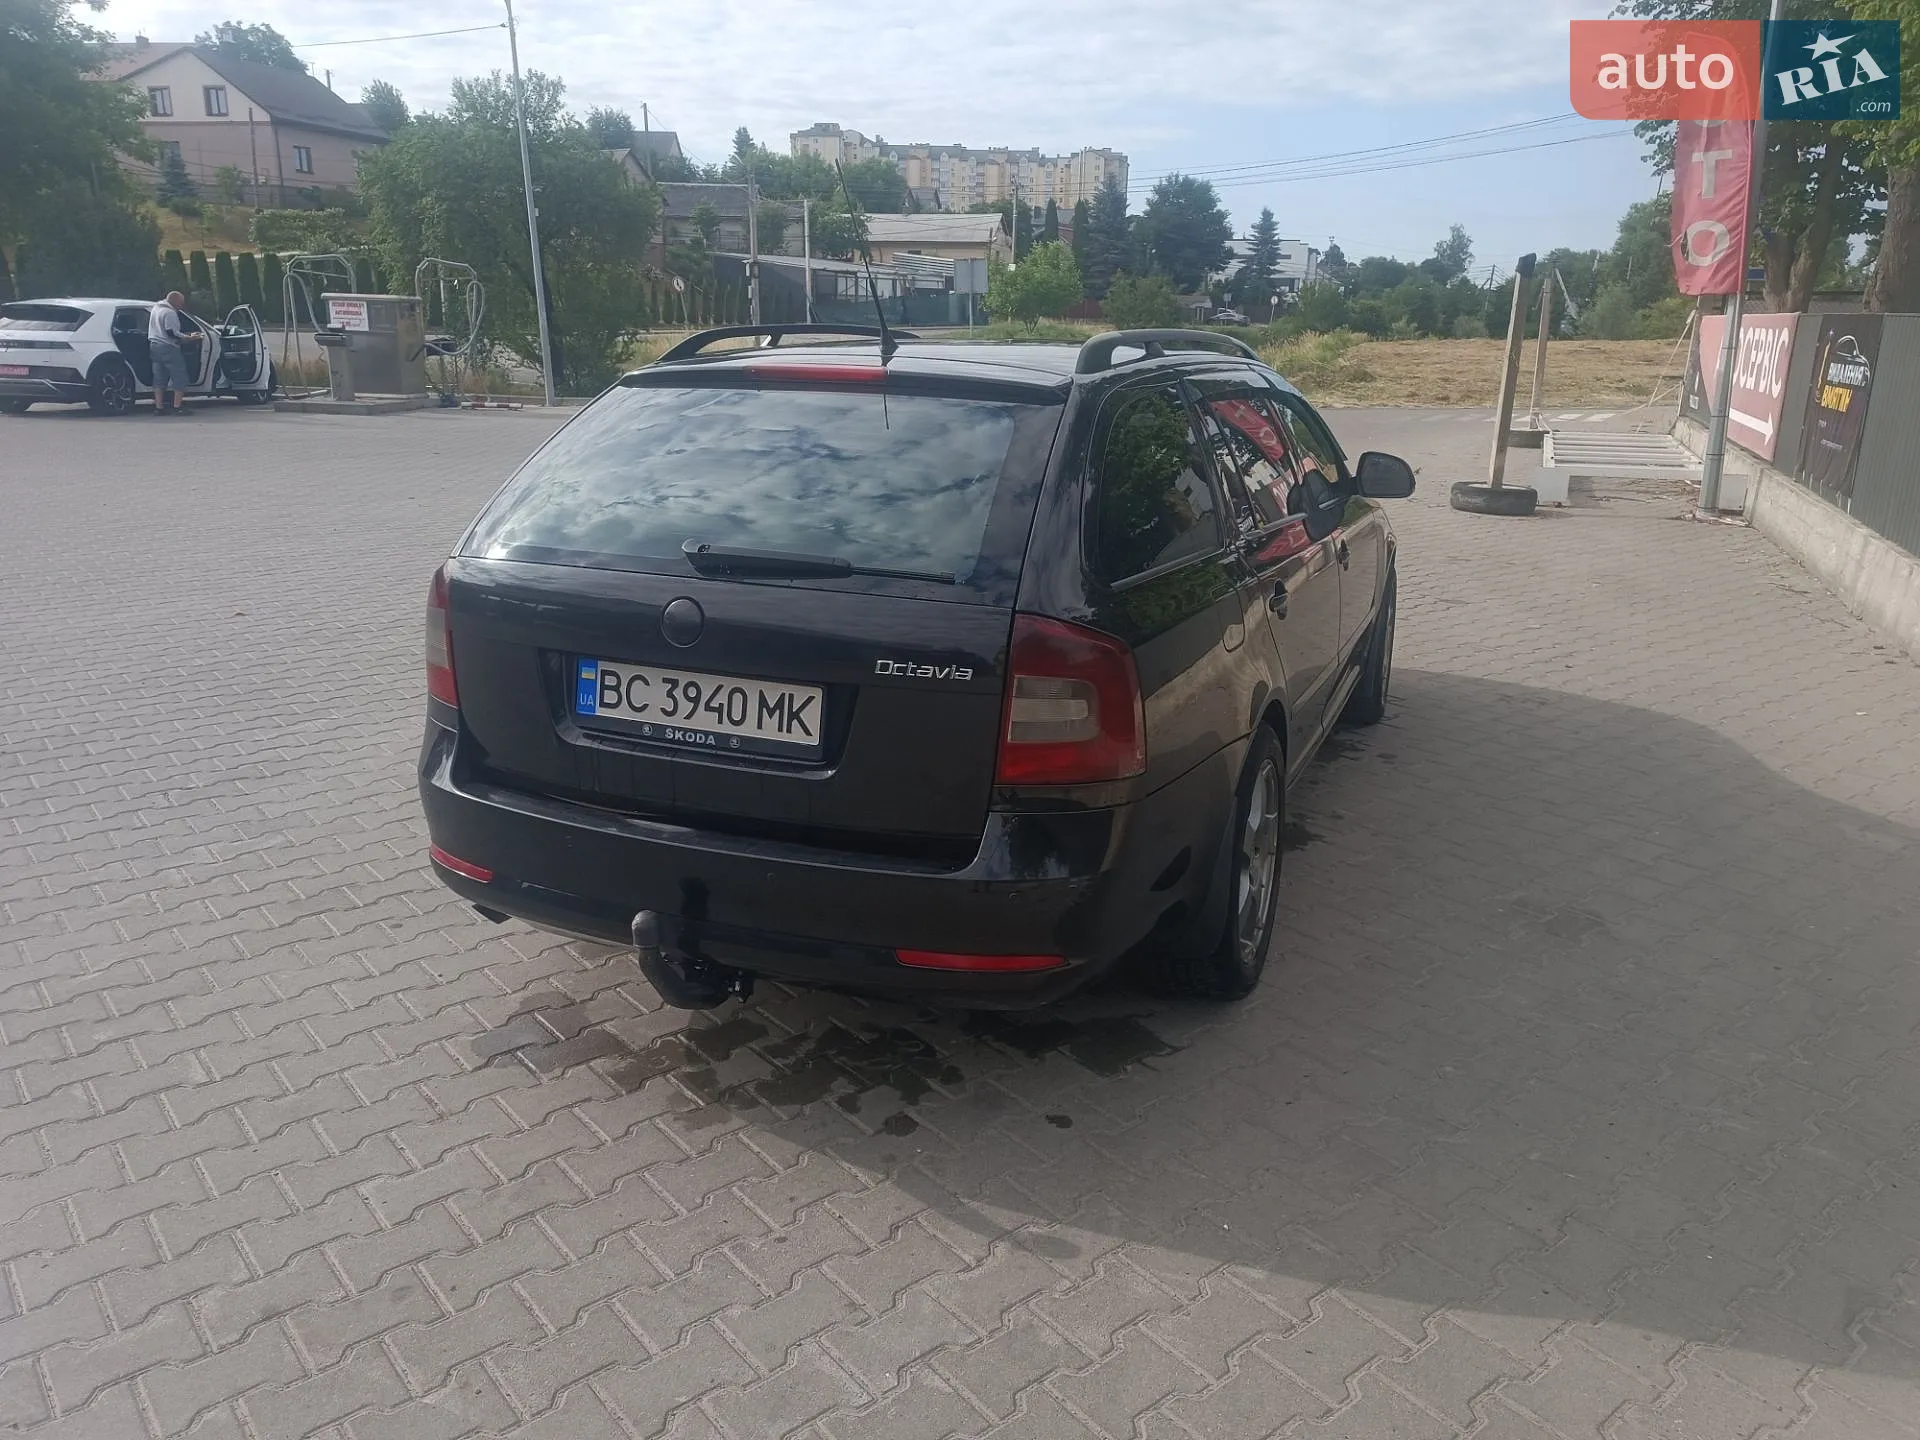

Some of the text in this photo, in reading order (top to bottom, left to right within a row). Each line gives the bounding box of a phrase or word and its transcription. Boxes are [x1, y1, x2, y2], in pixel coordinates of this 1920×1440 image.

[875, 660, 973, 680] Octavia
[580, 692, 594, 706] UA
[599, 669, 816, 737] BC 3940 MK
